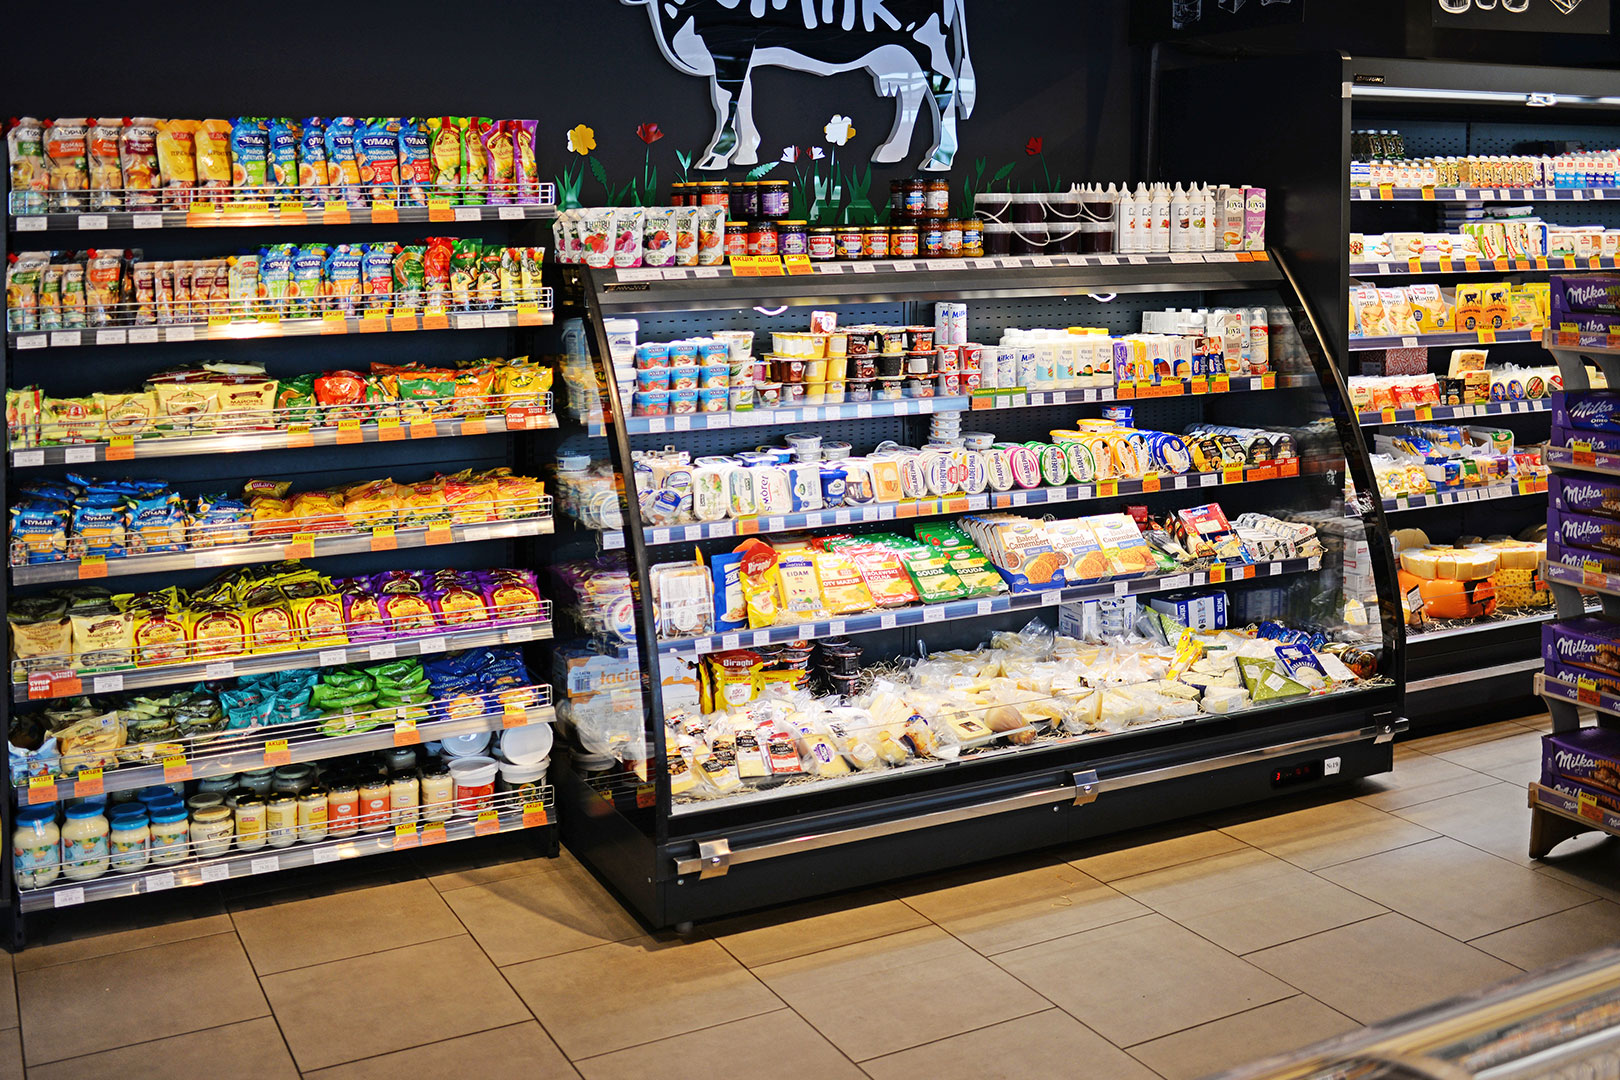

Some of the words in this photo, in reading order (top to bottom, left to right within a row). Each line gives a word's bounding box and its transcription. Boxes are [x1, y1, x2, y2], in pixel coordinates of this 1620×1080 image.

[1226, 199, 1243, 209] Joya
[1247, 199, 1265, 209] Joya
[756, 256, 780, 264] АКЦІЯ
[1566, 284, 1607, 305] Milka
[1225, 327, 1241, 336] Joya
[1579, 336, 1597, 345] Milka
[1569, 400, 1614, 418] Milka
[1548, 450, 1563, 460] Milka
[1050, 447, 1060, 483] PHILADELPHIA
[968, 454, 976, 492] PHILADELPHIA
[1563, 485, 1602, 504] Milka
[1561, 520, 1601, 539] Milka
[1015, 533, 1040, 543] Baked
[1102, 532, 1141, 543] Camembert
[1008, 538, 1050, 551] Camembert
[916, 568, 945, 577] GOUDA
[956, 566, 985, 575] GOUDA
[1548, 566, 1565, 576] Milka
[1556, 637, 1596, 656] Milka
[723, 658, 753, 667] Biraghi
[1555, 750, 1596, 770] Milka
